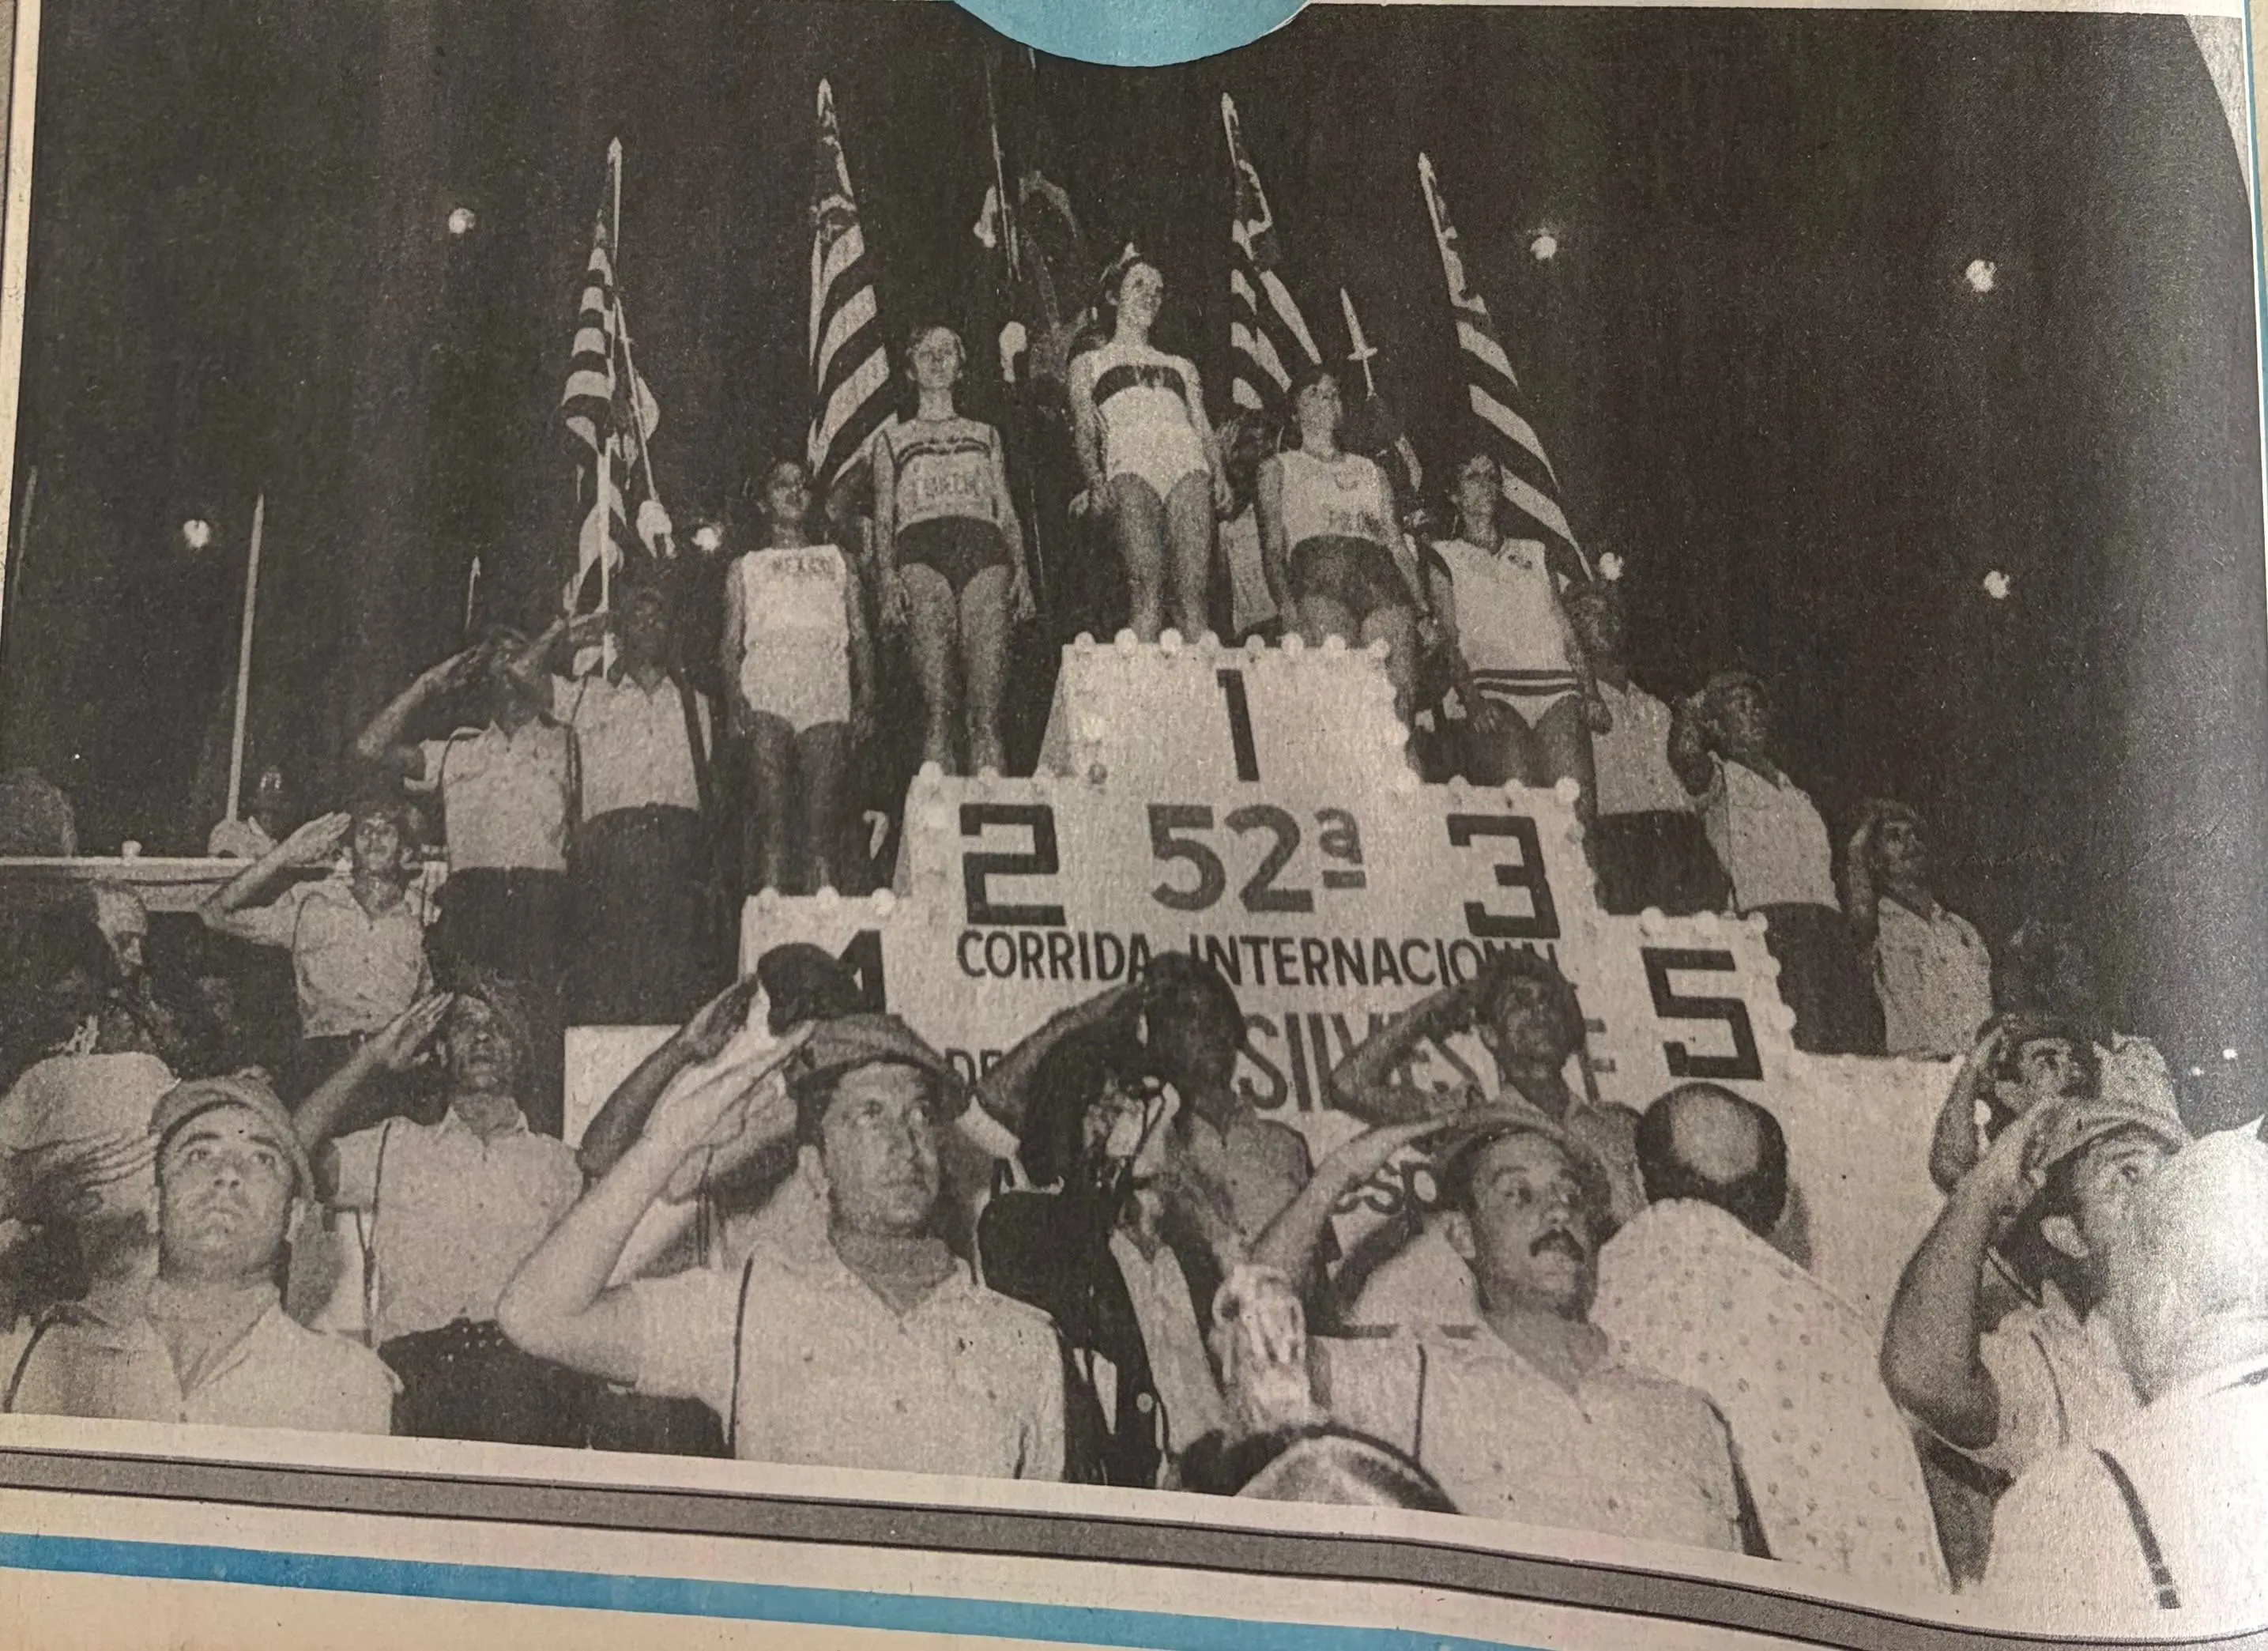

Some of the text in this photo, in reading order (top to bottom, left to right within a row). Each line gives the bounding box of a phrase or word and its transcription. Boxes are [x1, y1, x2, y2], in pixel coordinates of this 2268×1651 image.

[1216, 669, 1260, 782] 1
[959, 803, 1067, 928] 2
[1446, 813, 1562, 940] 3
[957, 930, 1153, 984] CORRIDA
[1640, 948, 1765, 1081] 5
